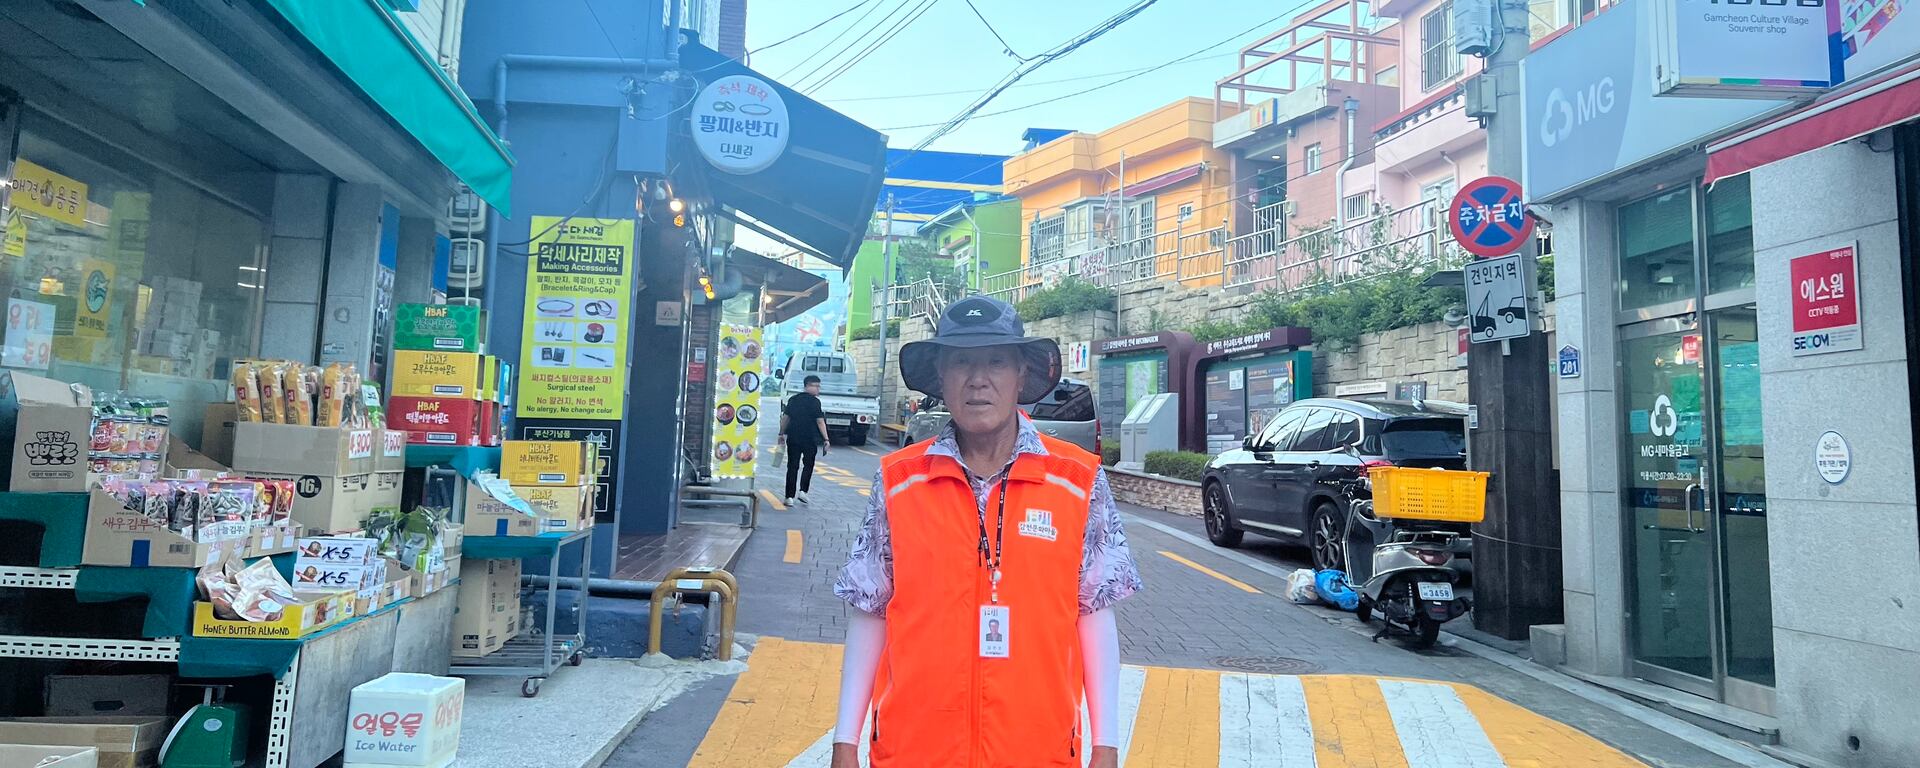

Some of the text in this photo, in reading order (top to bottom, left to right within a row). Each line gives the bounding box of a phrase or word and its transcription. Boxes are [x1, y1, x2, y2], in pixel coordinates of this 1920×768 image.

[1703, 13, 1809, 25] Gamcheon Culture Village
[1728, 24, 1787, 34] Souvenir shop
[1577, 76, 1615, 125] MG
[698, 115, 779, 138] 팔찌&반지
[720, 143, 753, 156] 다새김
[1459, 200, 1523, 226] 주차금지
[542, 262, 618, 272] Making Accessories
[1471, 261, 1517, 285] 견인지역
[1800, 273, 1844, 303] 에스원
[424, 307, 448, 318] HBAF
[1808, 307, 1823, 318] CCTV
[1794, 334, 1829, 350] SECOM
[424, 353, 448, 365] HBAF
[547, 383, 596, 392] Surgical steel
[417, 401, 440, 411] HBAF
[536, 396, 547, 404] No
[571, 406, 595, 415] change
[321, 545, 353, 560] X-5
[317, 570, 349, 584] X-5
[203, 624, 290, 636] HONEY BUTTER ALMOND
[352, 711, 424, 738] 얼음물
[355, 740, 417, 753] Ice Water
